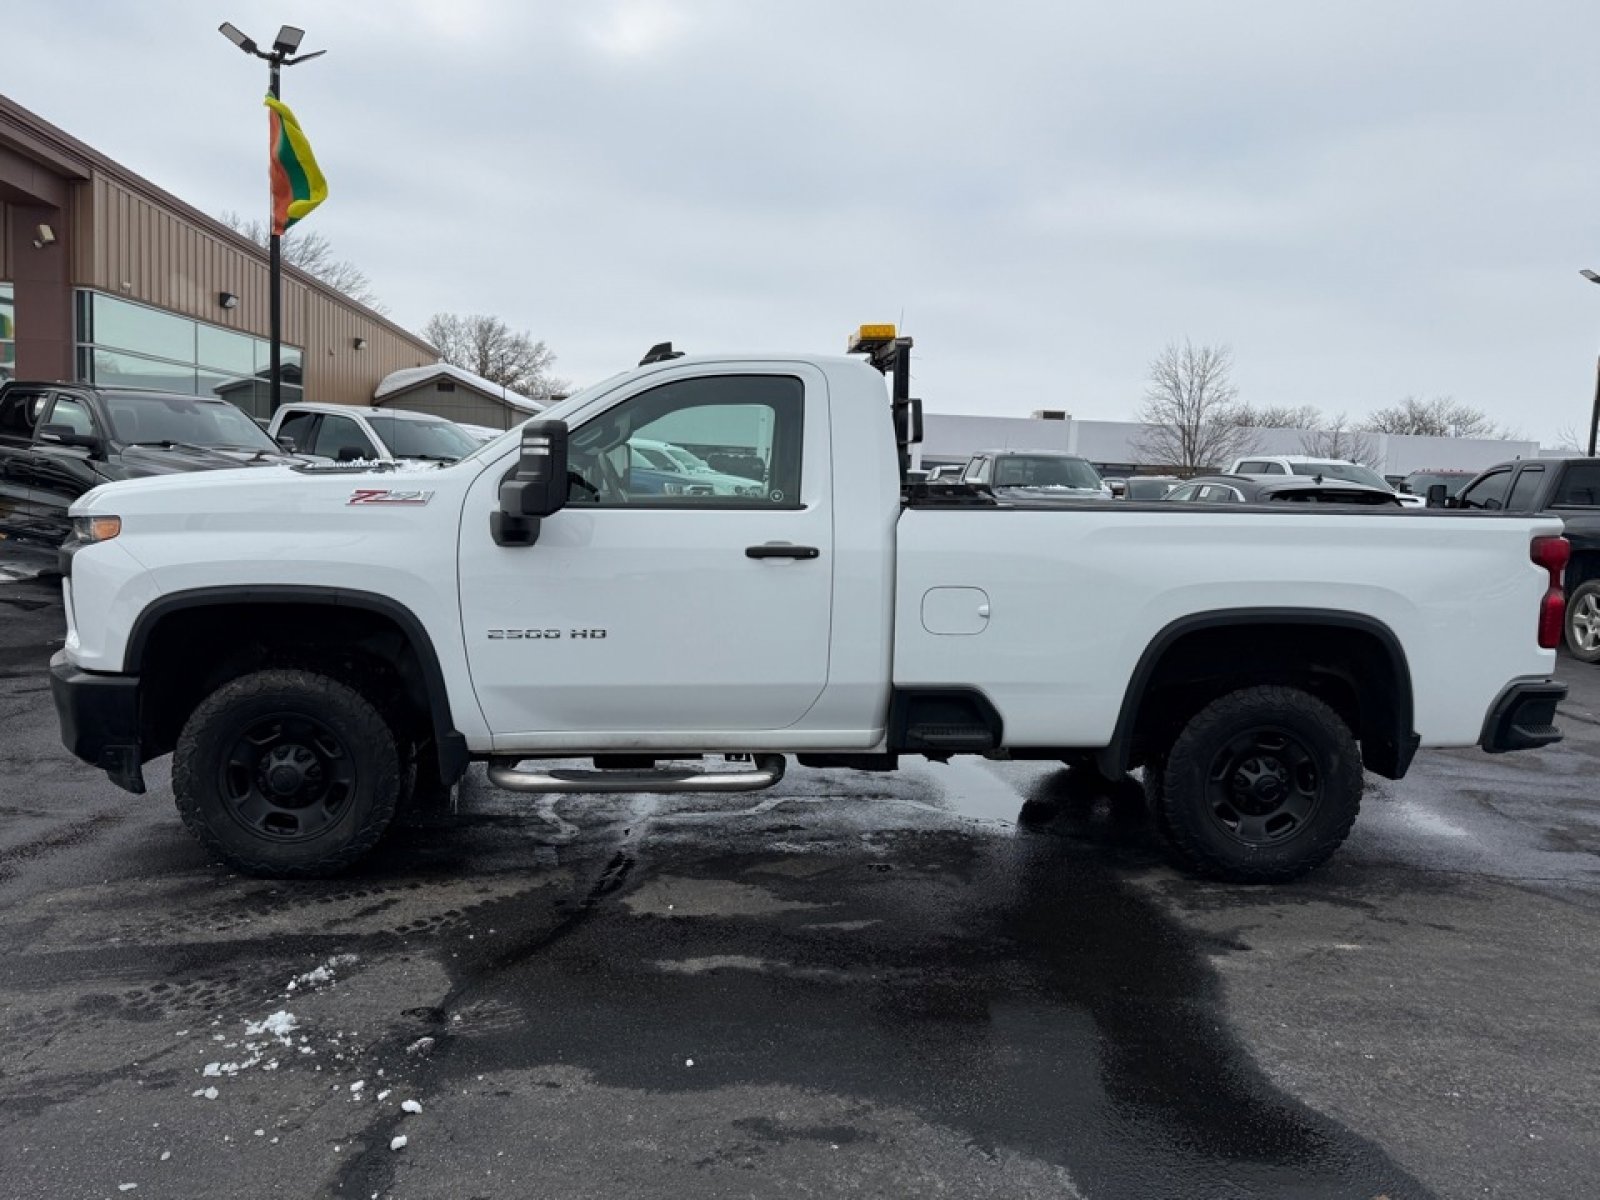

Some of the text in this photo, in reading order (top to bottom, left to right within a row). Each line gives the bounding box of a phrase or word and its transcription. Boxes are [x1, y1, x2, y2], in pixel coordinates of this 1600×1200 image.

[346, 489, 435, 506] Z71
[487, 629, 607, 639] 2500 HD
